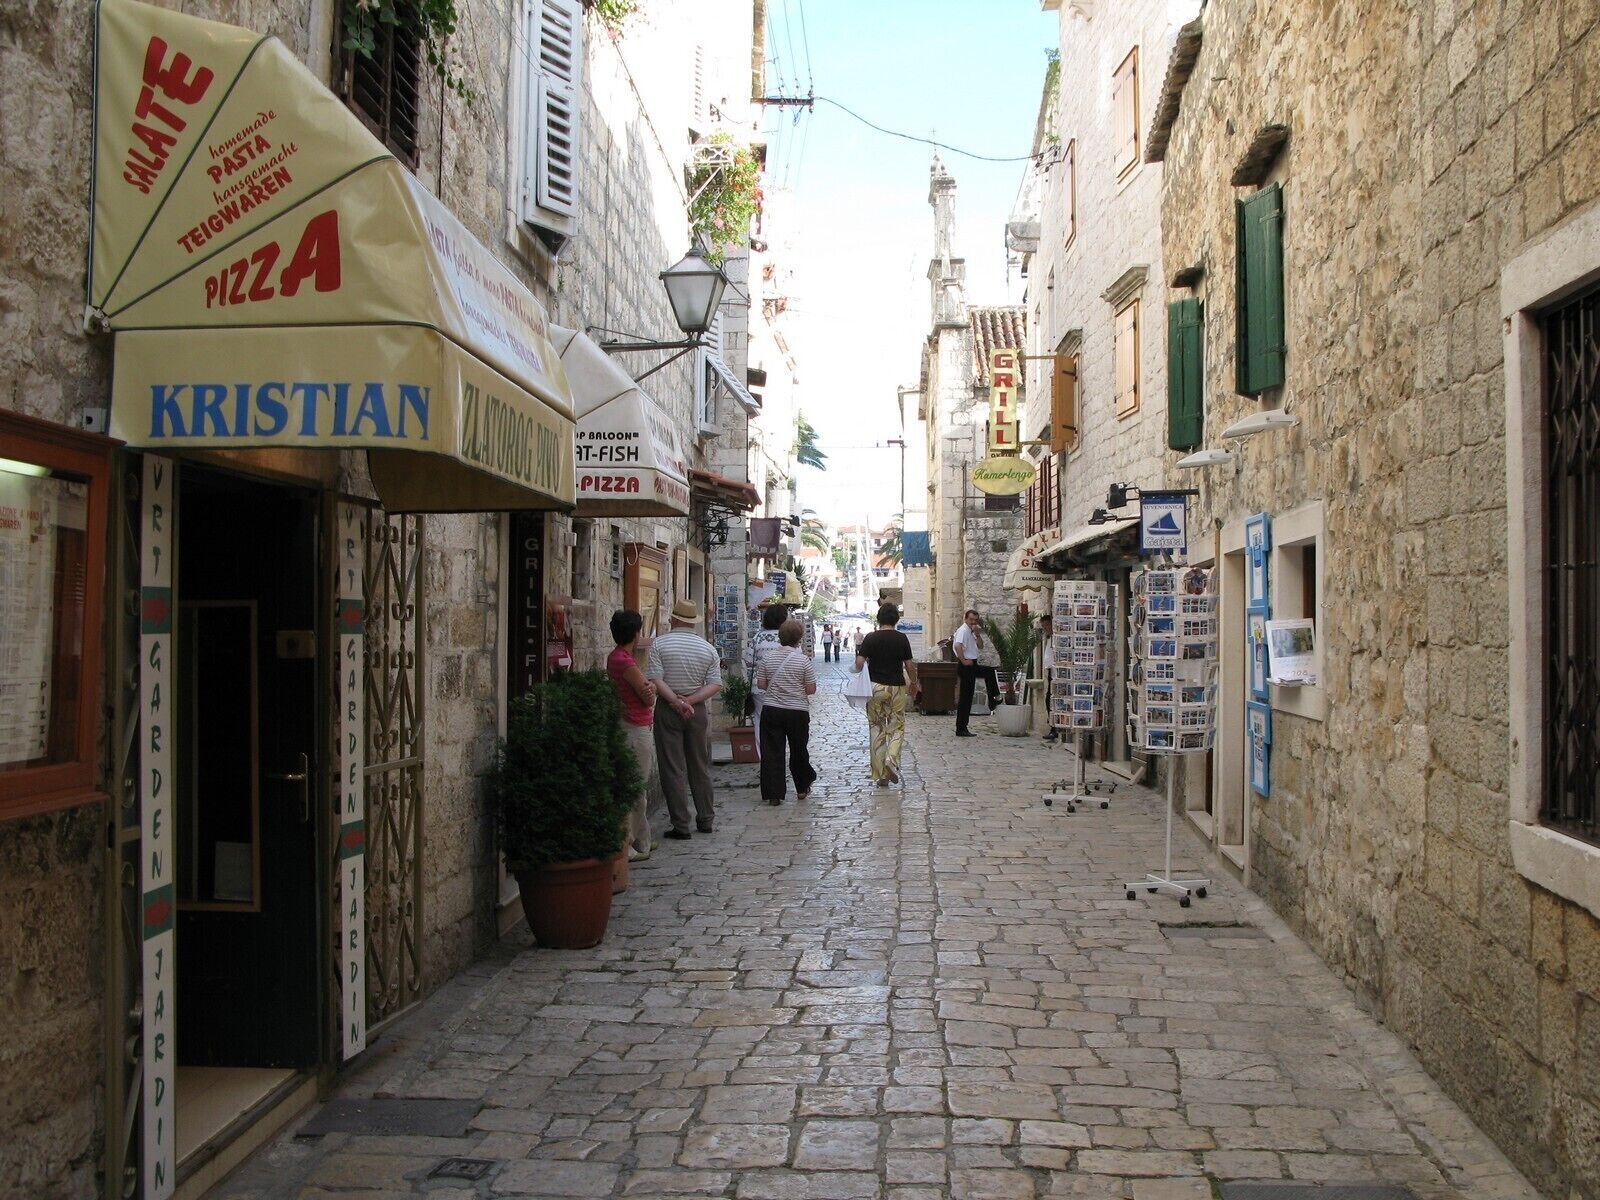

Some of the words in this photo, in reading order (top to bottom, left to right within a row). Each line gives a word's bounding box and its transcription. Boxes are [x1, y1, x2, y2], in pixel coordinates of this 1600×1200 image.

[123, 36, 214, 195] SALATE
[206, 134, 272, 184] PASTA
[208, 109, 277, 160] homemade
[177, 166, 293, 253] TEIGWAREN
[213, 142, 299, 205] hausgemacht
[205, 209, 341, 308] PIZZA
[149, 382, 430, 440] KRISTIAN
[461, 381, 533, 483] ZLATOROG
[534, 422, 560, 494] PIVO
[588, 432, 632, 441] BALOON
[993, 353, 1014, 445] GRILL
[152, 463, 163, 577] VRT
[973, 468, 1034, 482] Kamerlengo
[345, 508, 355, 592] VRT
[524, 538, 539, 628] GRILL
[1021, 530, 1059, 568] GRILL
[149, 640, 163, 881] GARDEN
[346, 638, 358, 814] GARDEN
[348, 867, 360, 1044] JARDIN
[153, 948, 166, 1191] JARDIN
